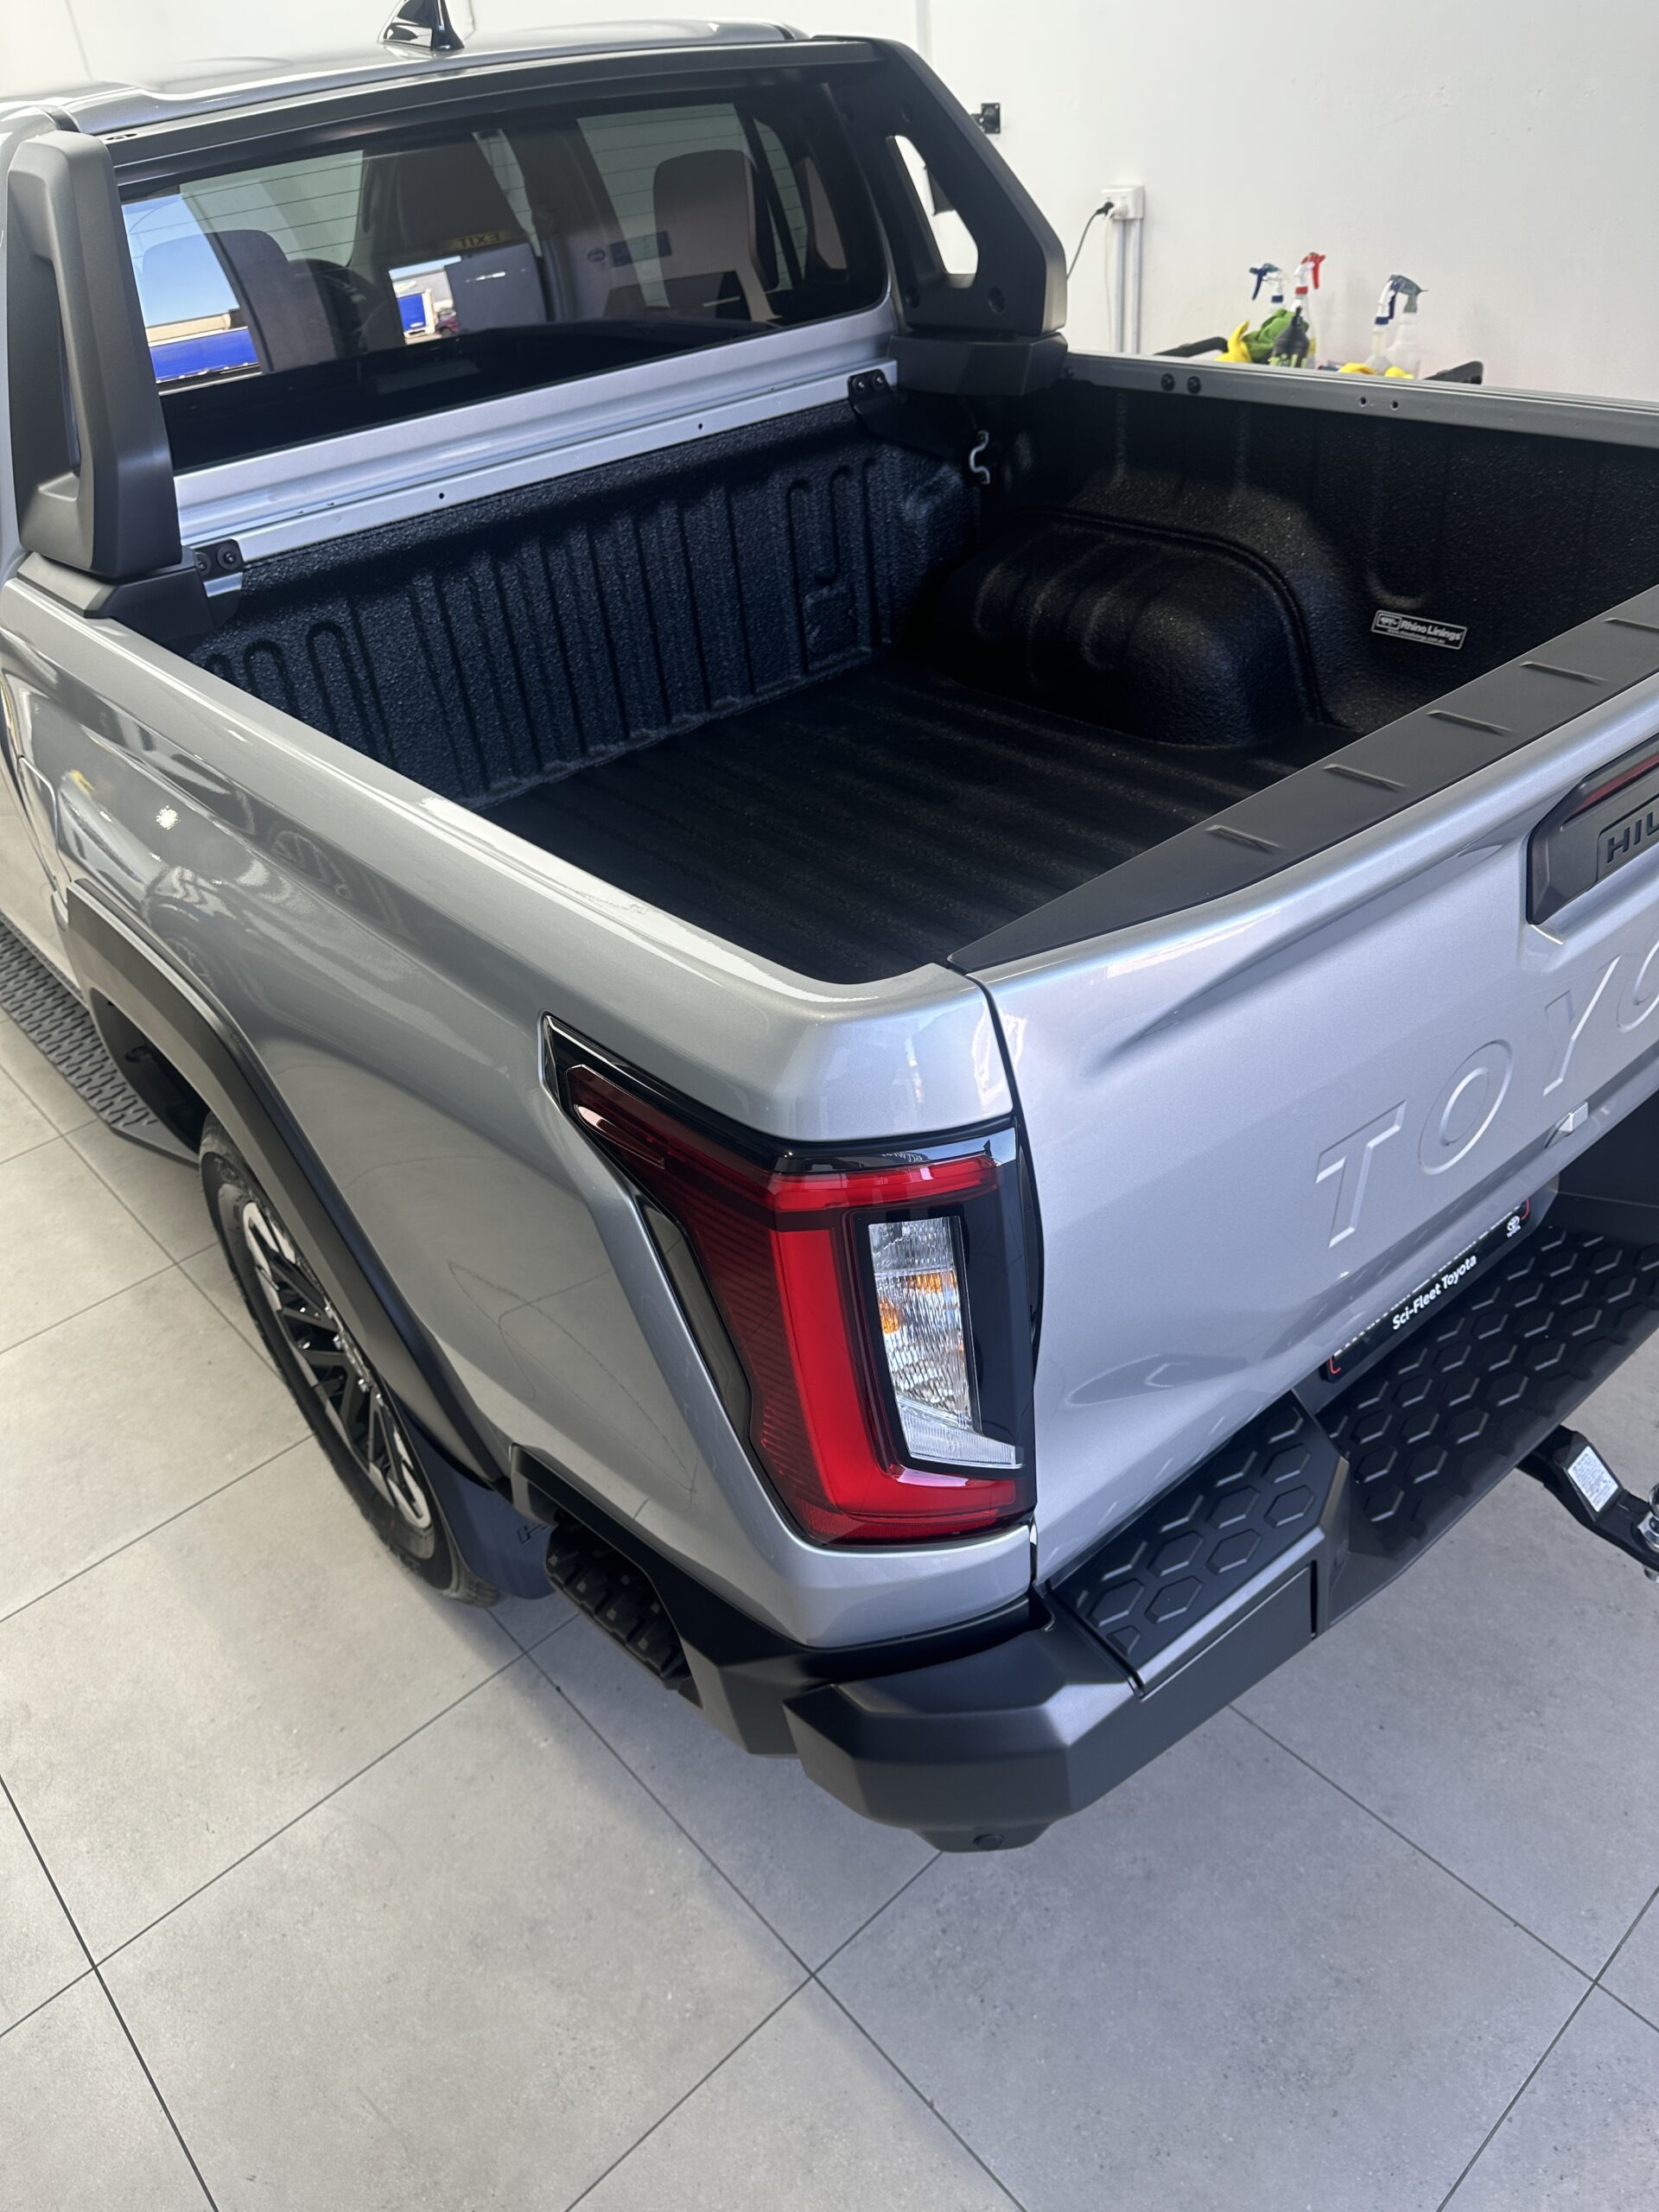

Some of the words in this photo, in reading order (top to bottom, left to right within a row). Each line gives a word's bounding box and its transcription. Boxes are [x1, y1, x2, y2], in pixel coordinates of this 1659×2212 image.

[1401, 620, 1427, 633] Rhino
[1427, 626, 1461, 641] Linings
[1393, 1283, 1441, 1330] Sci-Fleet
[1441, 1255, 1477, 1289] Toyota
